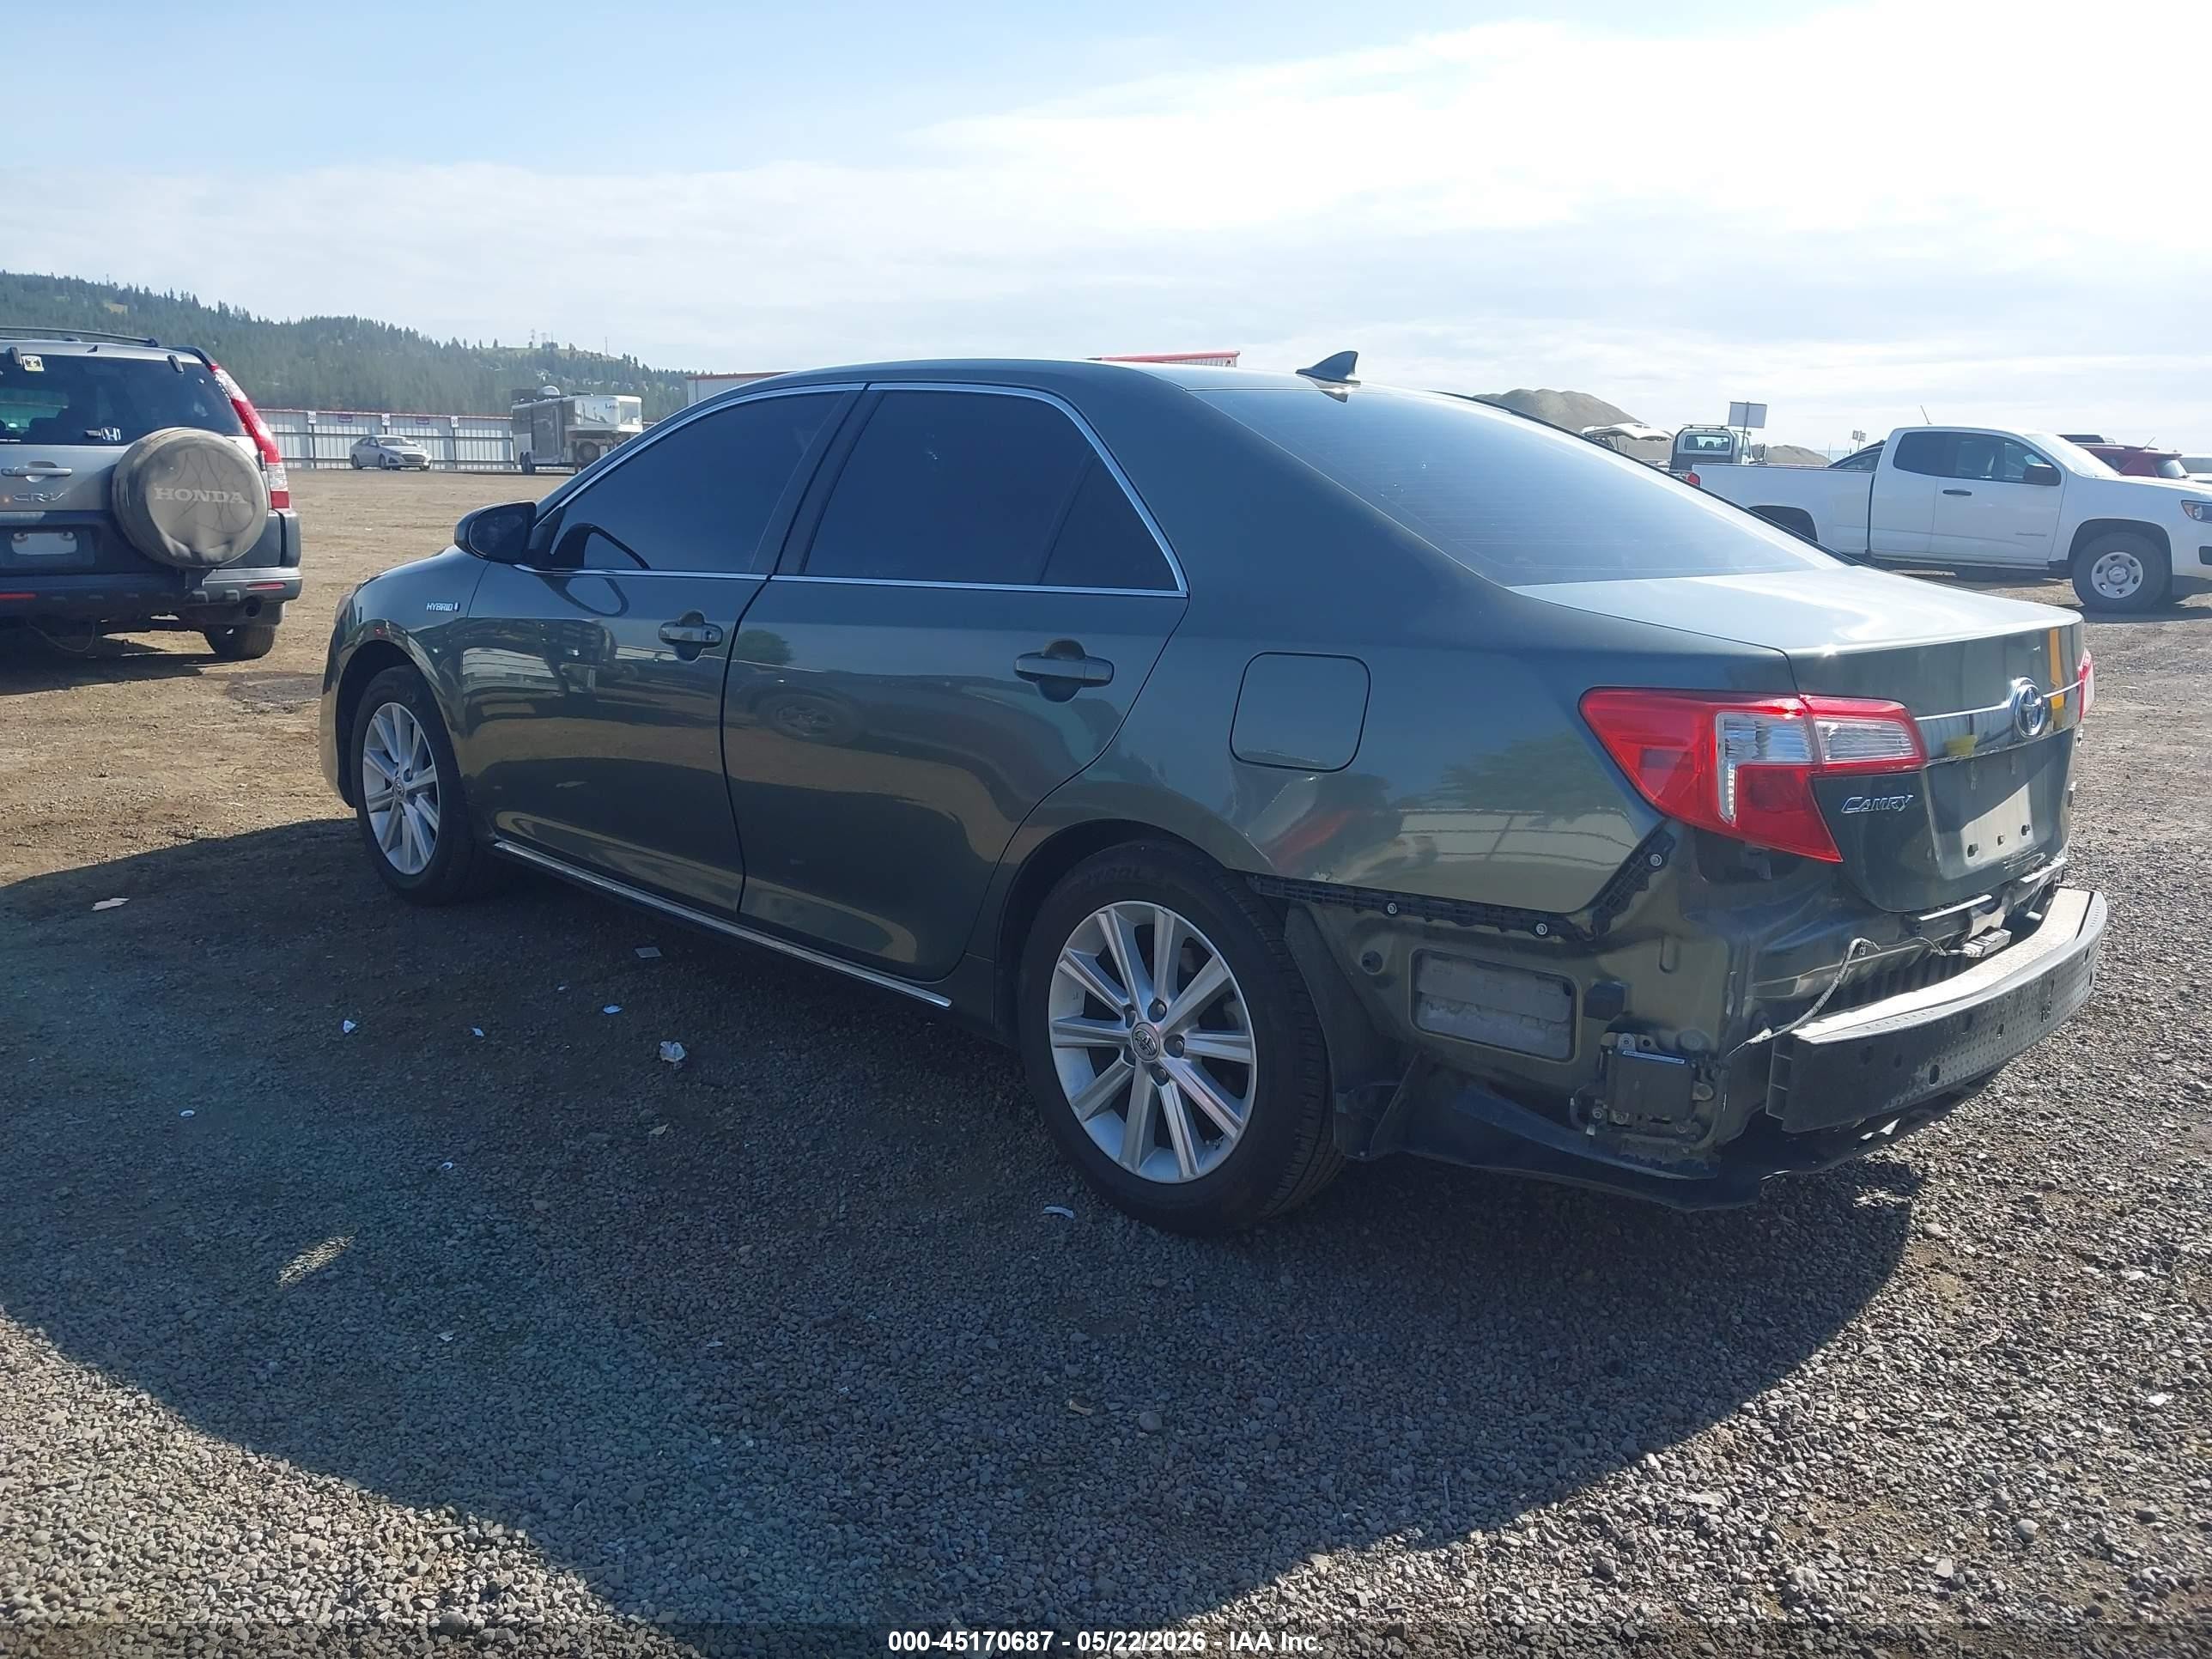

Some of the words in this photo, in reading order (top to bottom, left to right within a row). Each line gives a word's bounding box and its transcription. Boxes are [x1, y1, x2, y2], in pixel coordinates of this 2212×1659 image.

[13, 489, 68, 502] CR-V
[154, 487, 248, 504] HONDA
[426, 602, 453, 611] HYBRID
[1841, 794, 1914, 814] CAMRY
